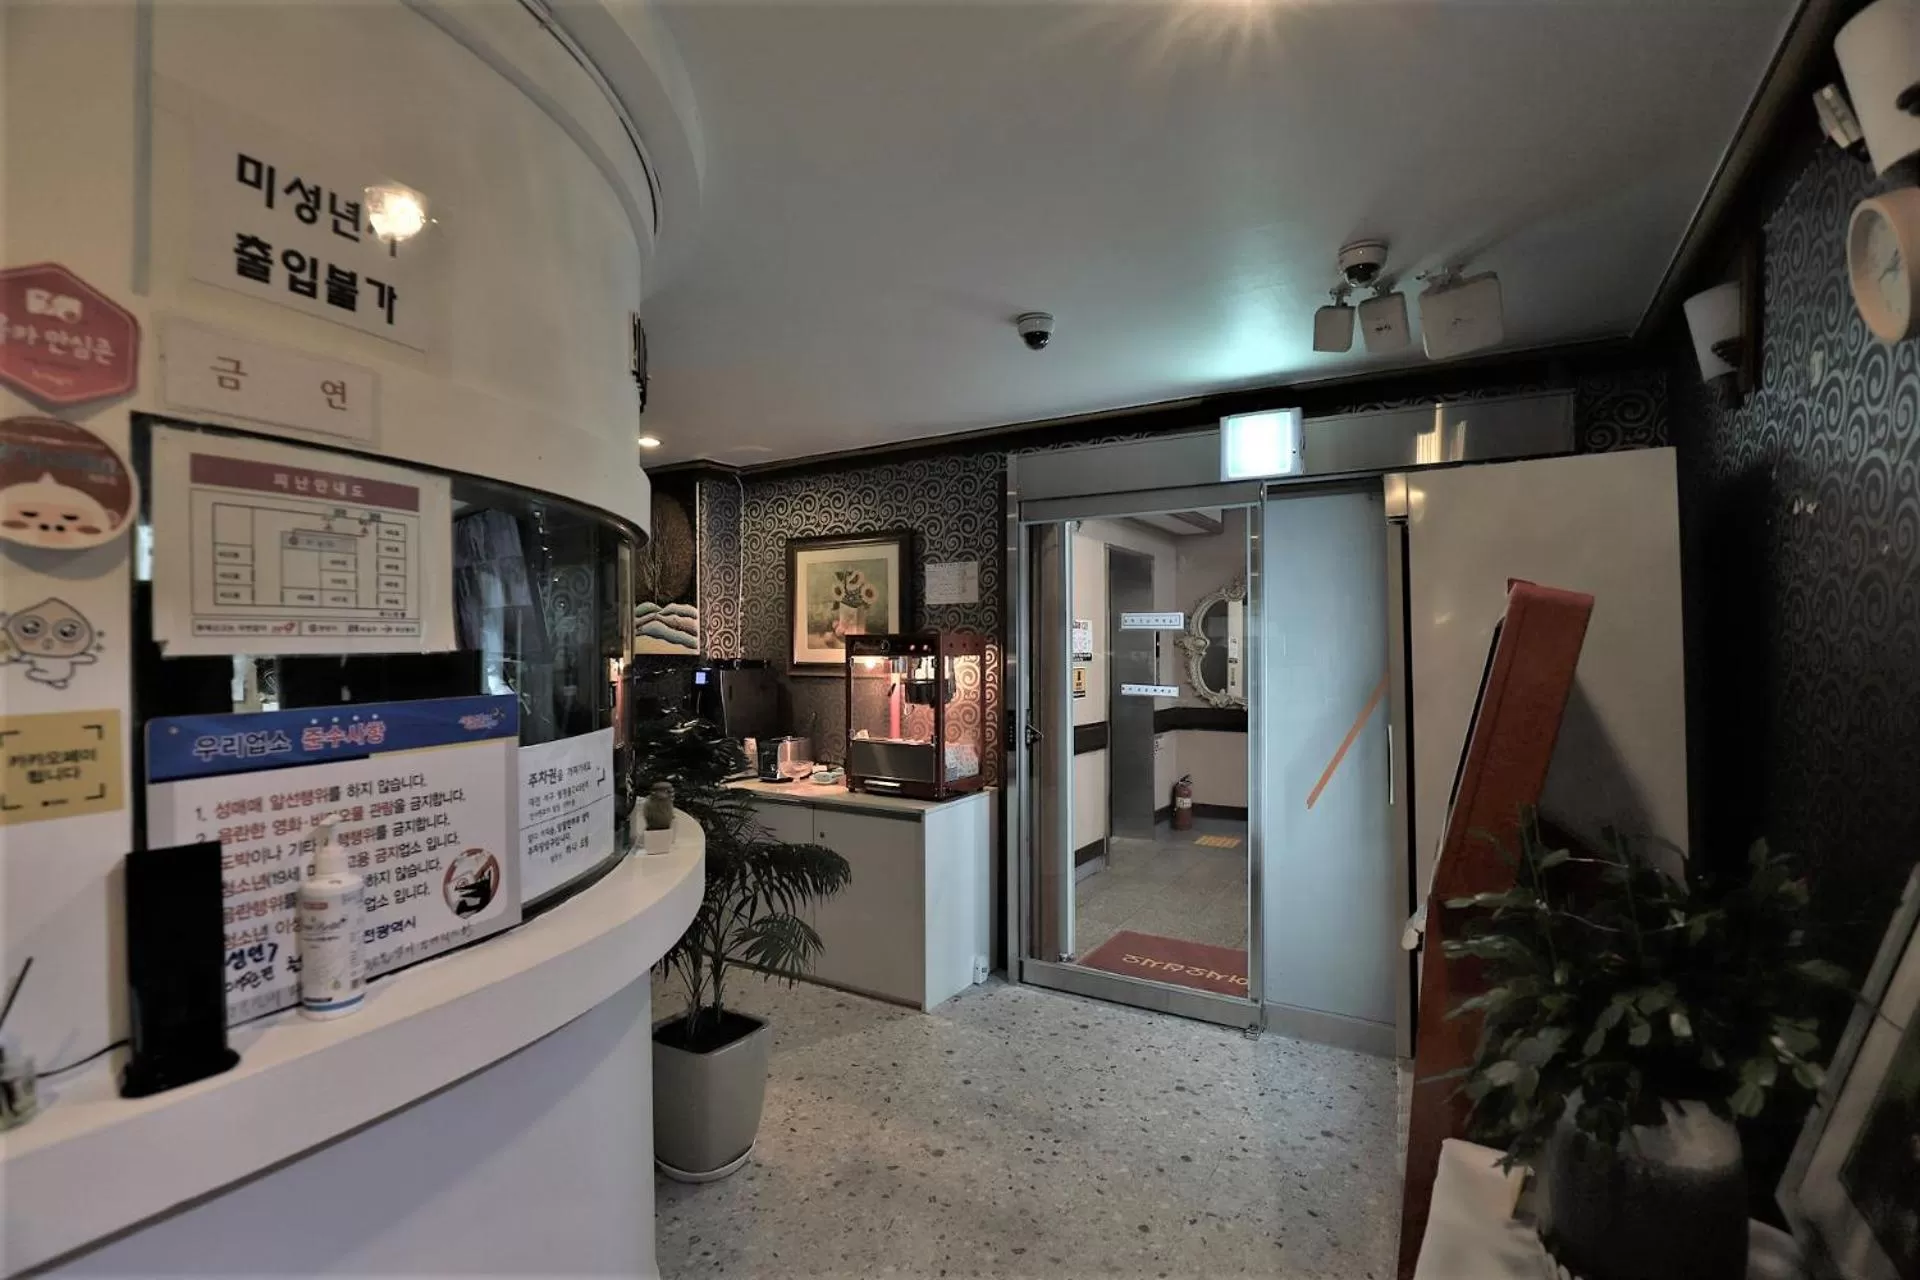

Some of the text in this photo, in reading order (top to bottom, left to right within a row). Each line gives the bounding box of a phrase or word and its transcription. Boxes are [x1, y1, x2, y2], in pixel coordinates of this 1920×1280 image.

[233, 232, 398, 326] 출입불가
[209, 355, 348, 411] 금 연
[193, 719, 387, 762] 우리업소 준수사항
[214, 796, 264, 820] 성매매
[269, 785, 341, 811] 알선행위를
[346, 781, 373, 799] 하지
[377, 772, 427, 794] 않습니다.
[218, 822, 267, 846] 음란한
[370, 797, 406, 819] 관람을
[410, 787, 467, 812] 금지합니다.
[392, 812, 451, 838] 금지합니다.
[374, 840, 423, 865] 금지업소
[426, 831, 460, 851] 입니다.
[364, 871, 391, 888] 하지
[394, 857, 442, 882] 않습니다.
[363, 892, 390, 912] 업소
[394, 881, 431, 904] 입니다.
[362, 915, 418, 945] 전광역시
